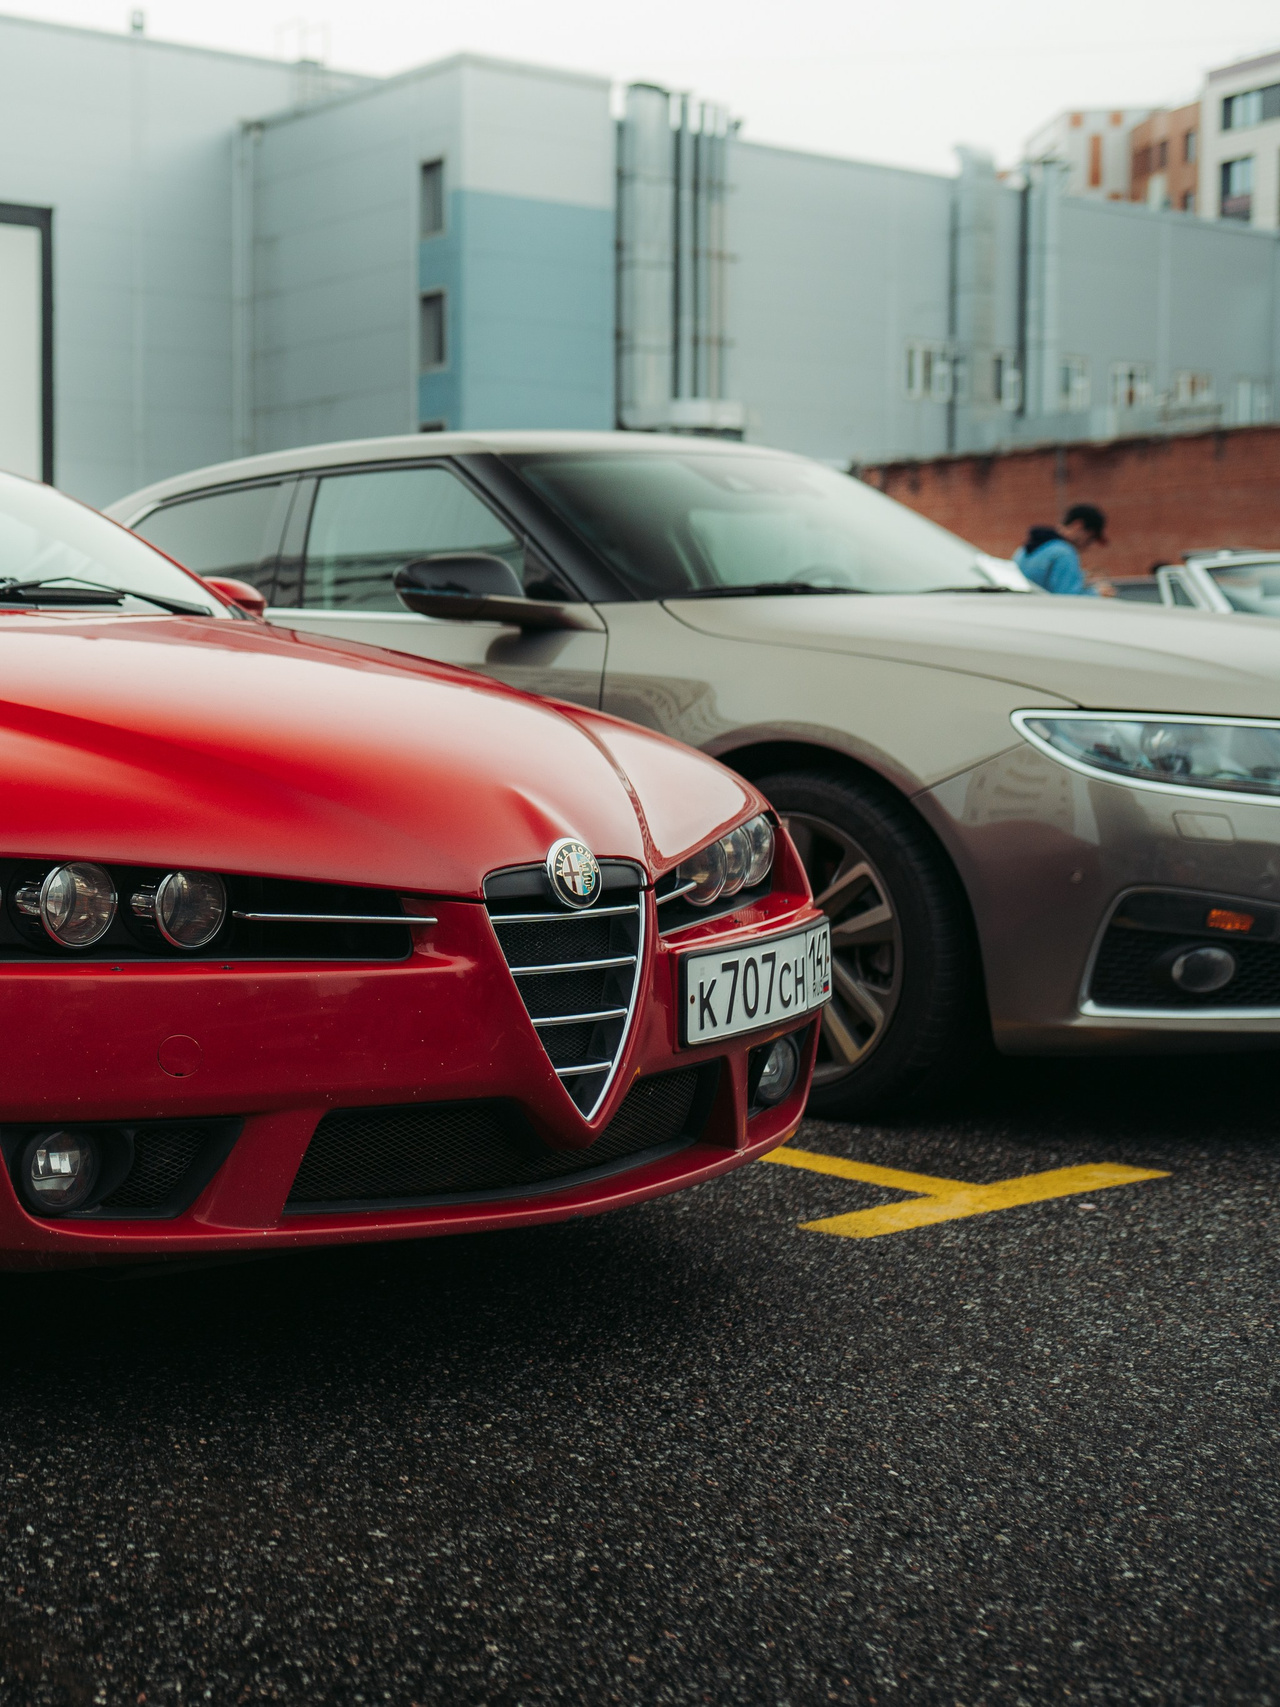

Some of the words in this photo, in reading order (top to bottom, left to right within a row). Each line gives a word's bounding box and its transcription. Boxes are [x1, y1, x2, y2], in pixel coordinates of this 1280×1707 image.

[556, 848, 569, 877] ALFA
[571, 844, 599, 873] ROMEO
[808, 930, 828, 981] 147
